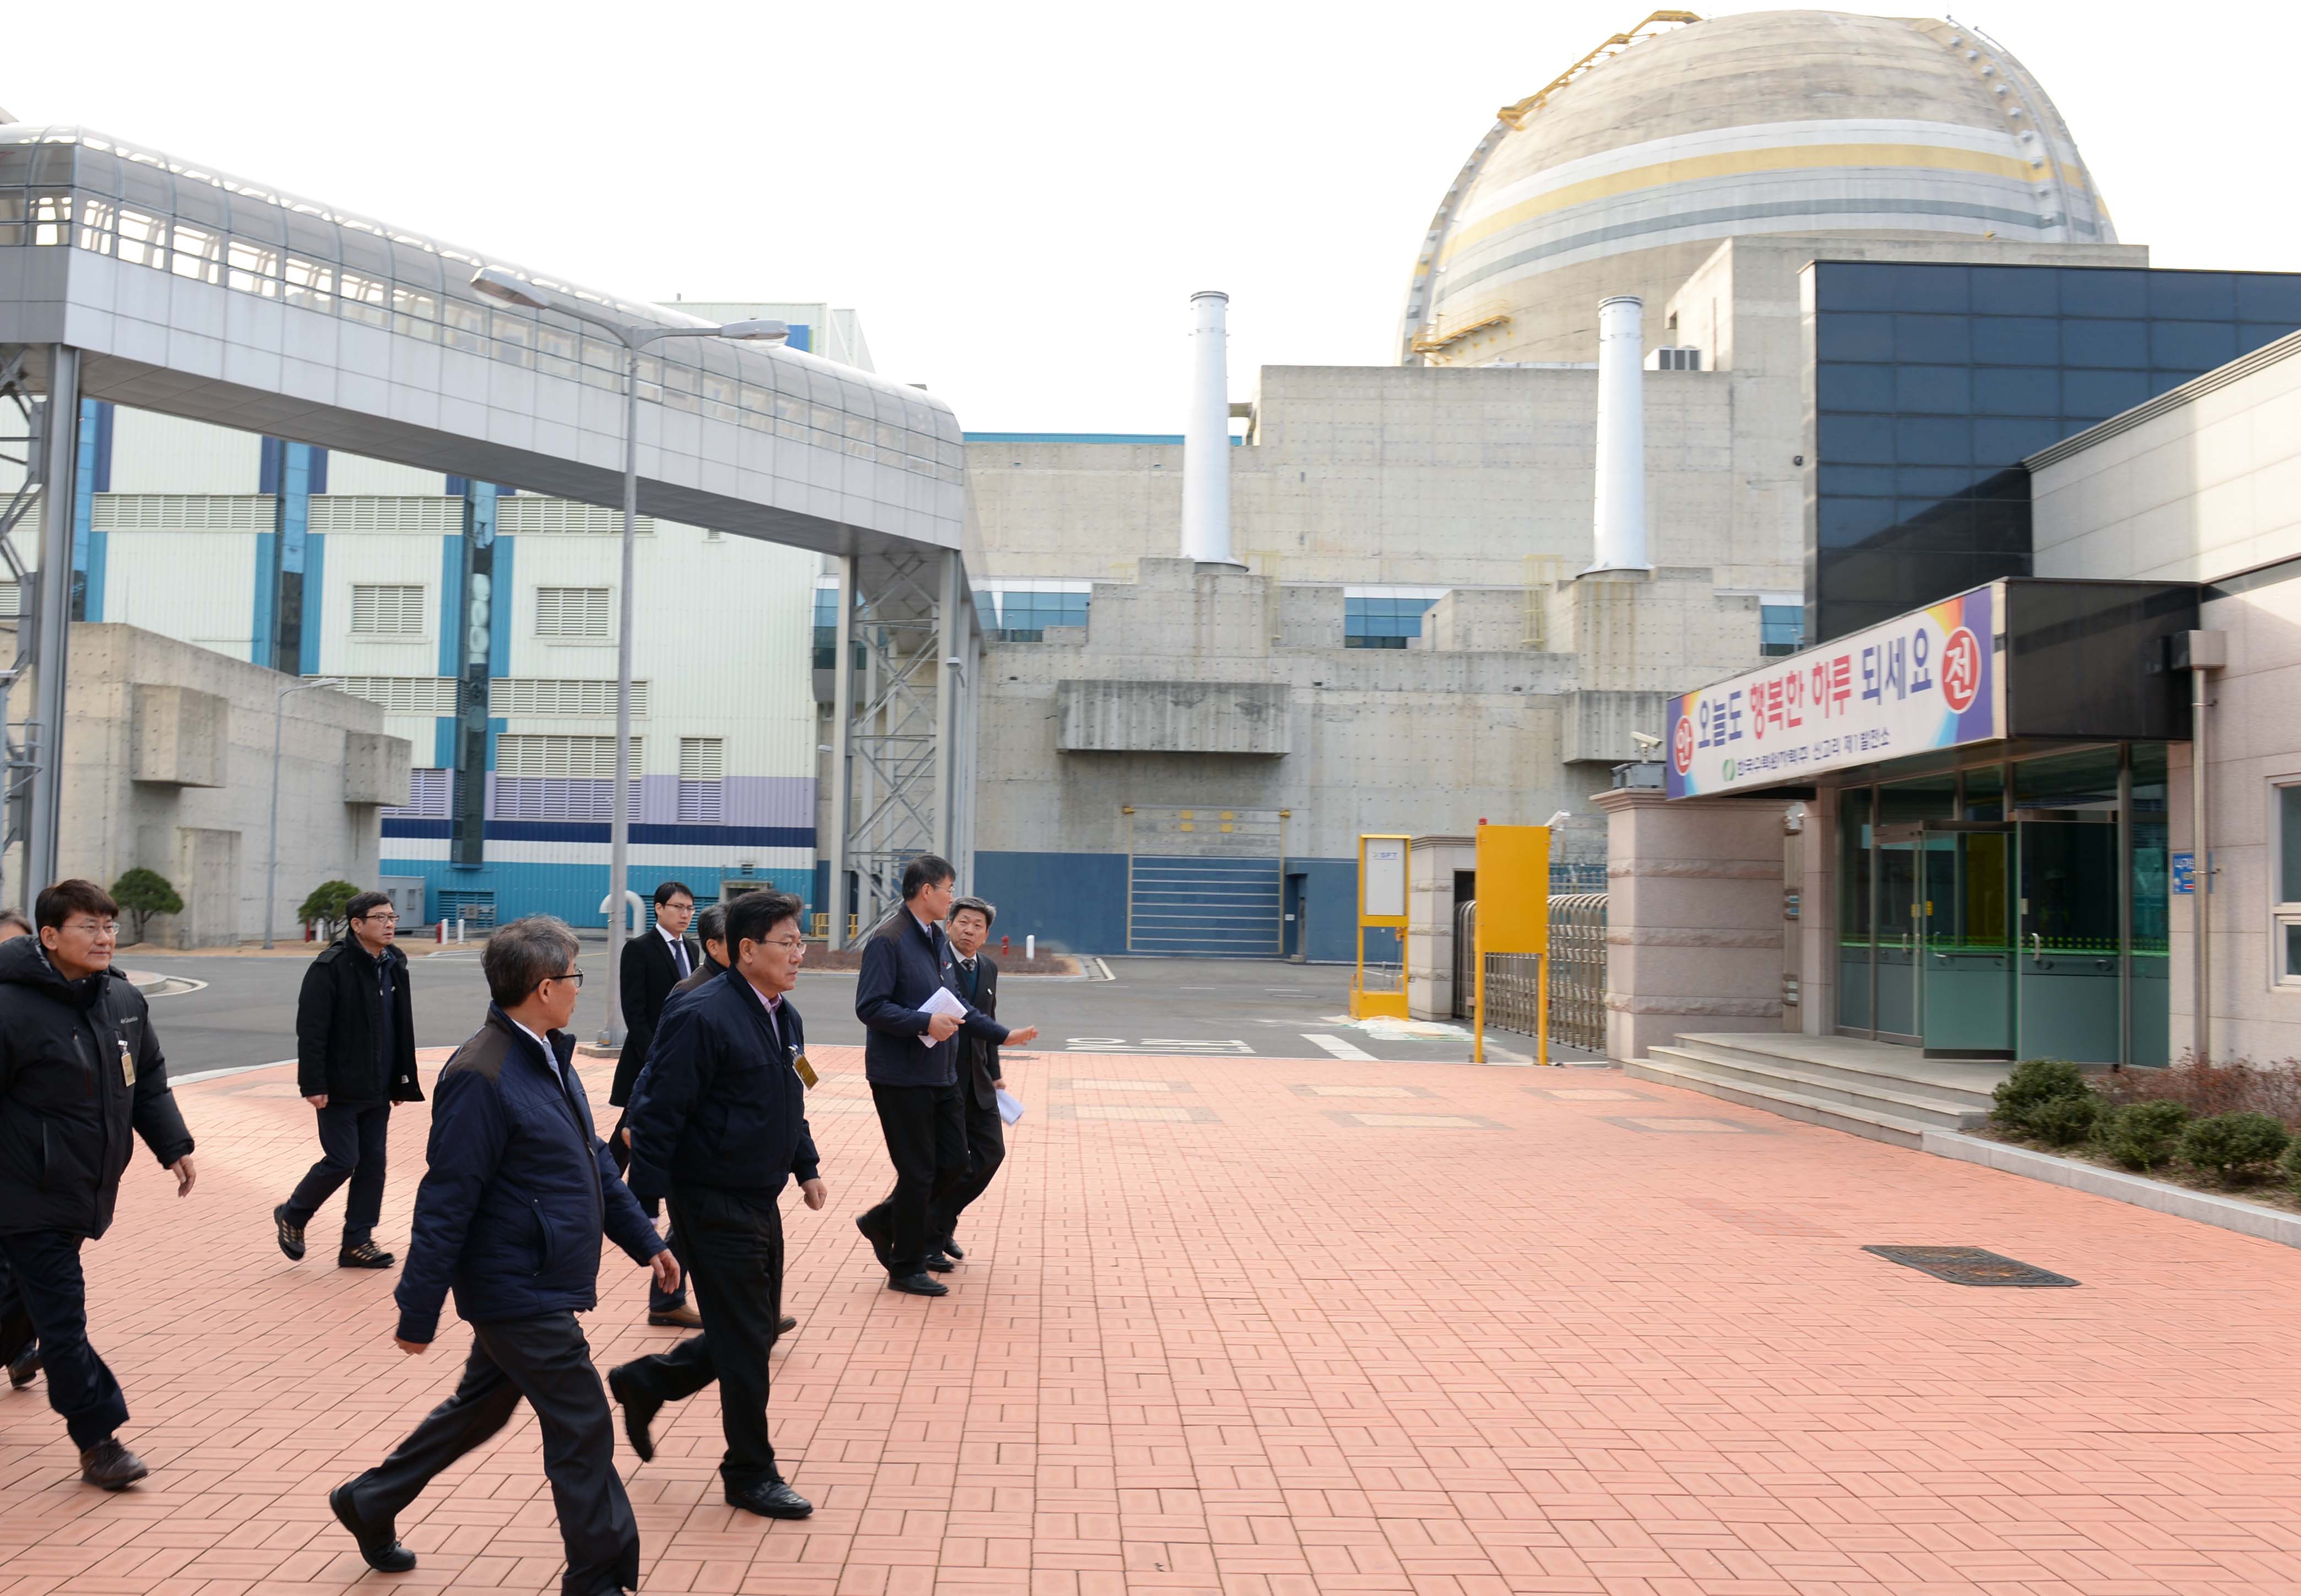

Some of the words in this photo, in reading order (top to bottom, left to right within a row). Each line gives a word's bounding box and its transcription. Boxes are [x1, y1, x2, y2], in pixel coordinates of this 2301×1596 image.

[1698, 690, 1742, 749] 오늘도
[1750, 670, 1804, 740] 행복한
[1811, 654, 1851, 719] 하루
[1862, 628, 1933, 705] 되세요
[1945, 637, 1973, 699] 전
[1675, 722, 1693, 766] 안
